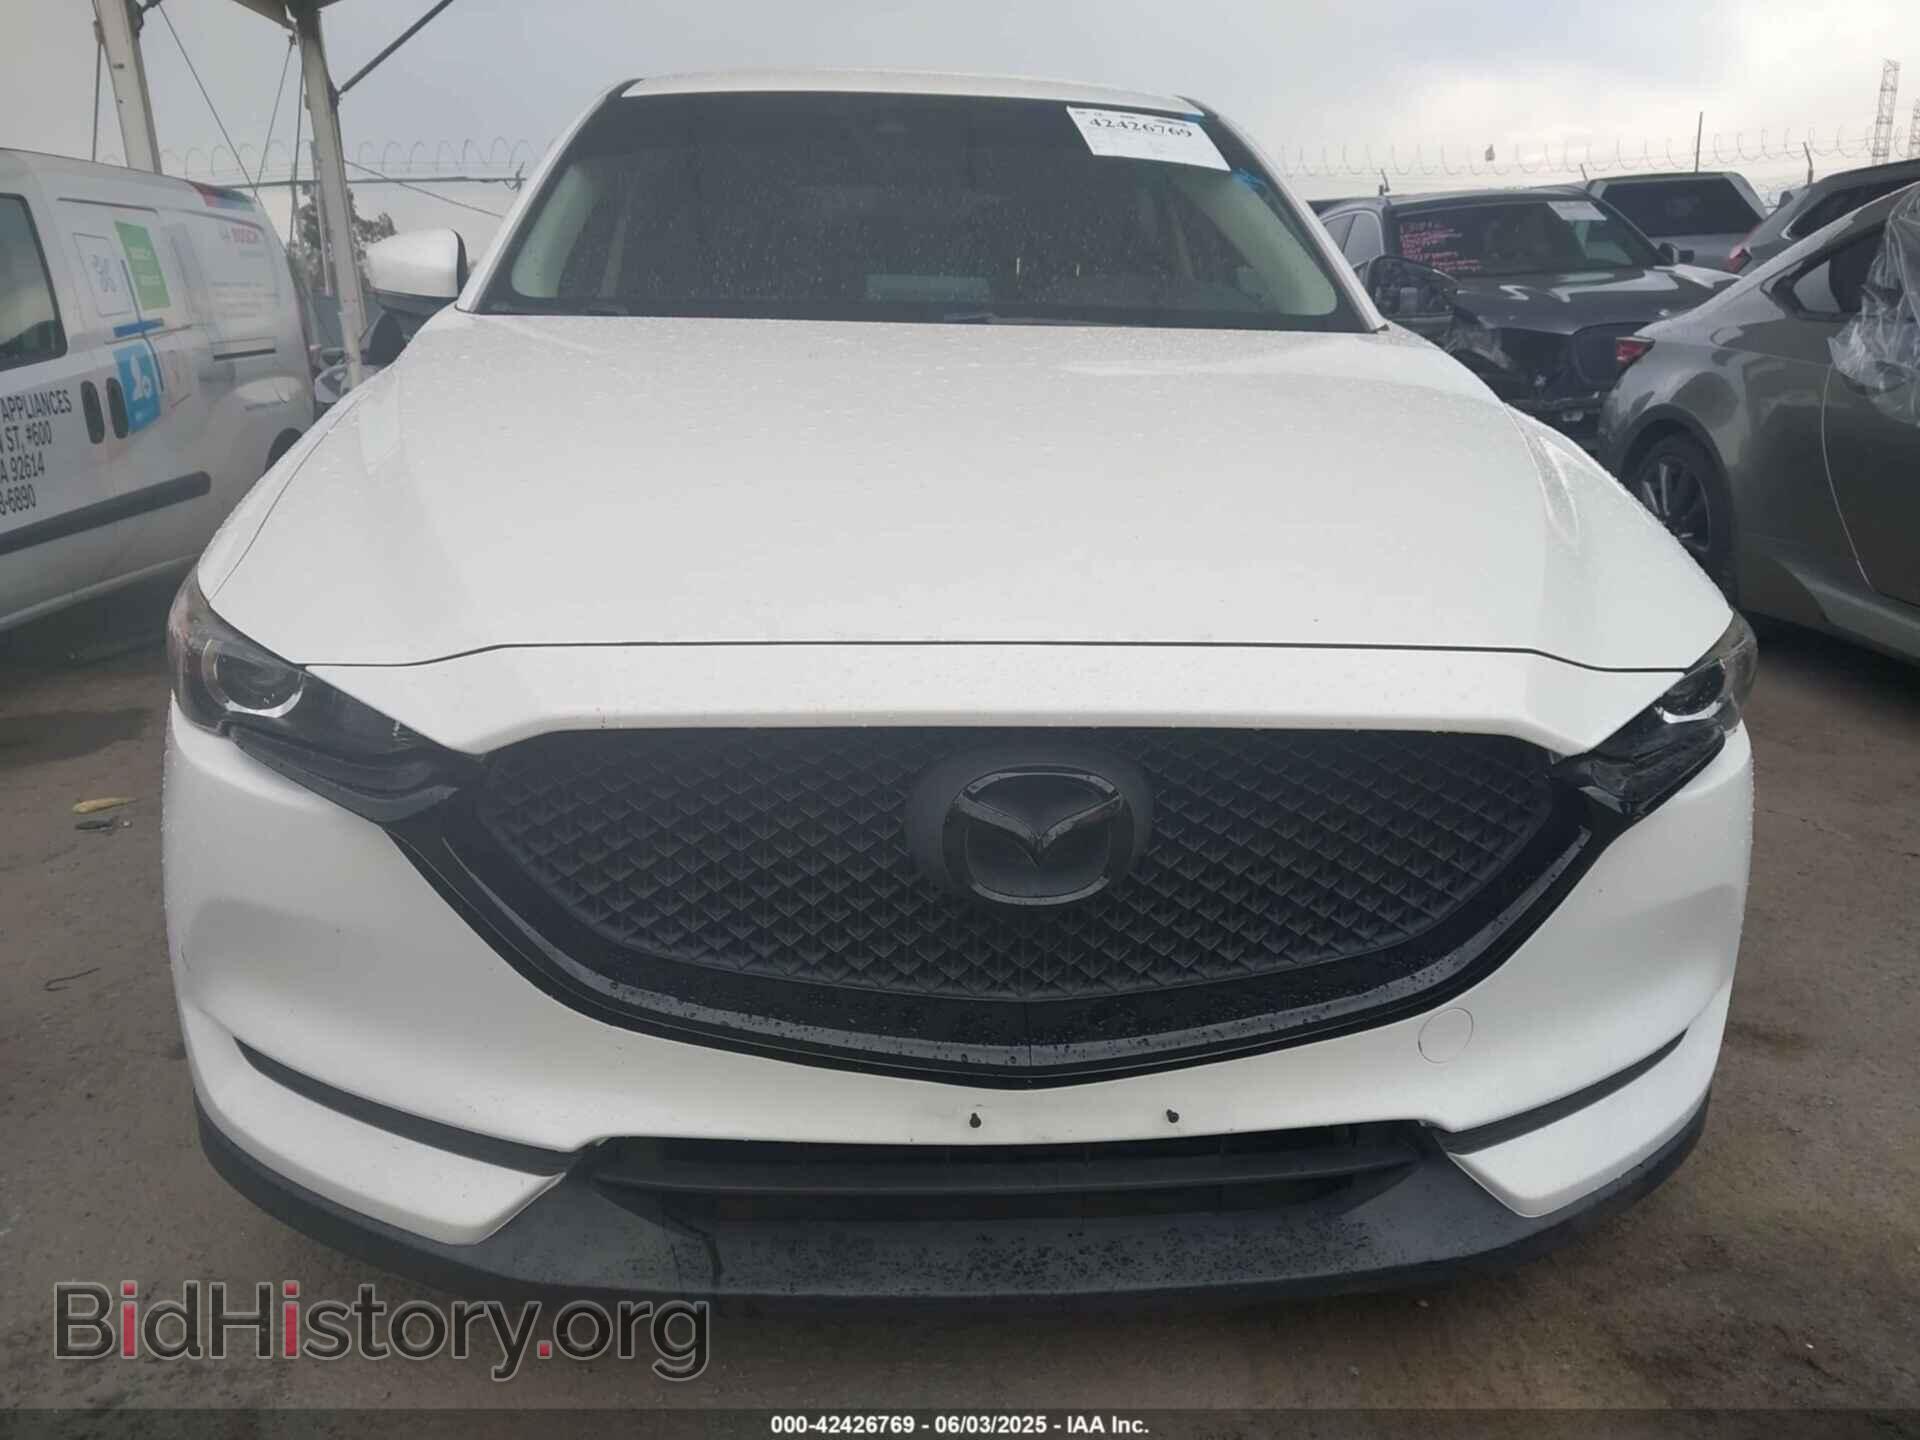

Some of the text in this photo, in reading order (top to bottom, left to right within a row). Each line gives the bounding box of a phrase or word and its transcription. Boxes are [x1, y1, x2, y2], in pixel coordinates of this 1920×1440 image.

[1089, 117, 1193, 138] 42426769
[0, 389, 72, 422] APPLIANCES
[10, 450, 45, 481] 92614
